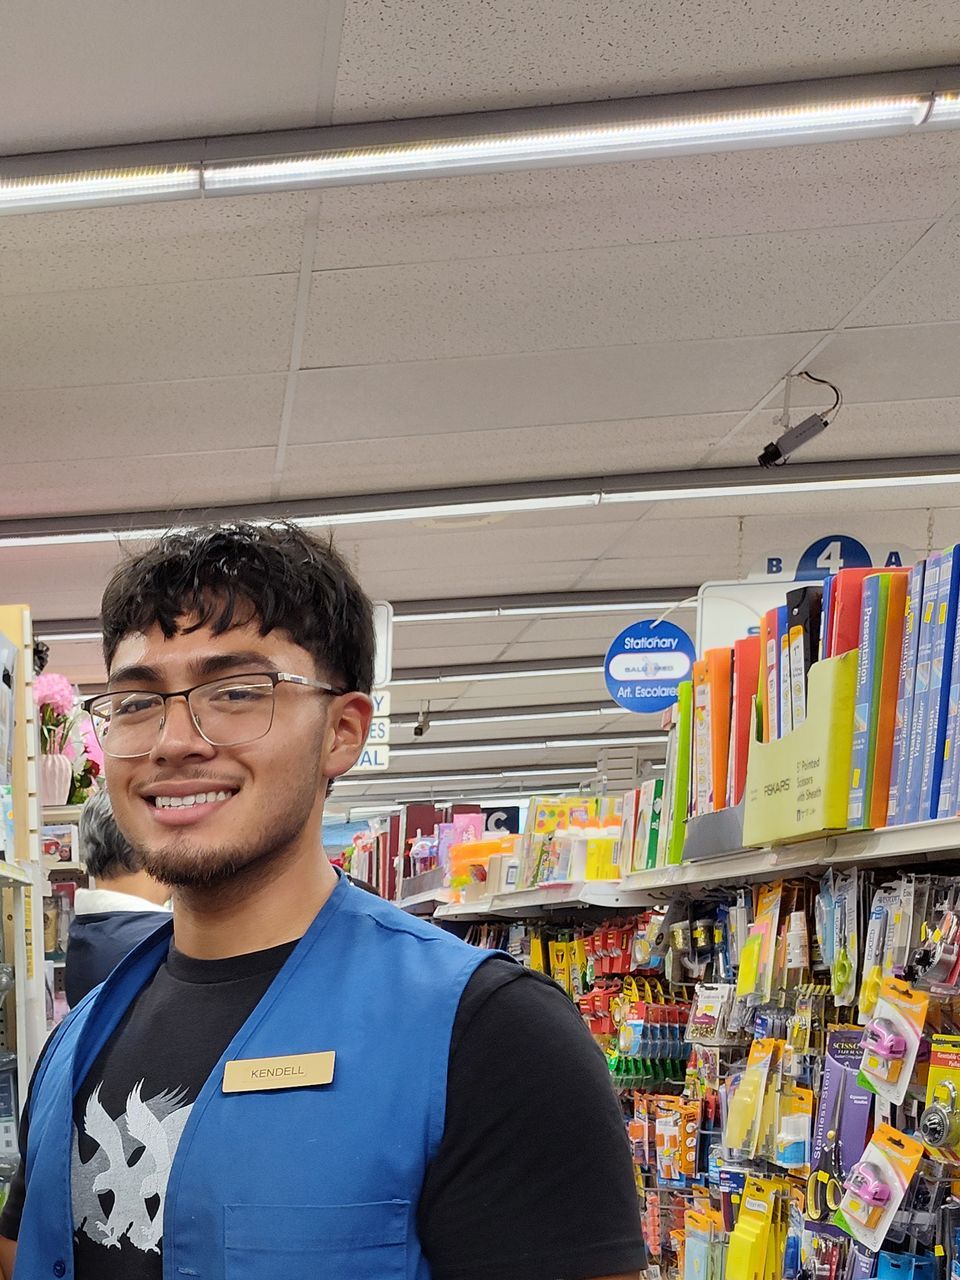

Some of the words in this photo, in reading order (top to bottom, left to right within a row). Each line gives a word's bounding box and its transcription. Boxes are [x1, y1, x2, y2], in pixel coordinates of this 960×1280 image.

[766, 557, 784, 575] B
[816, 541, 843, 575] 4
[884, 551, 904, 567] A
[624, 636, 680, 651] Stationary
[861, 606, 872, 685] Presentation
[617, 686, 633, 698] Art.
[634, 685, 680, 699] Escolares
[251, 1065, 304, 1079] KENDELL
[813, 1103, 827, 1160] Stainless
[822, 1068, 831, 1099] Steel
